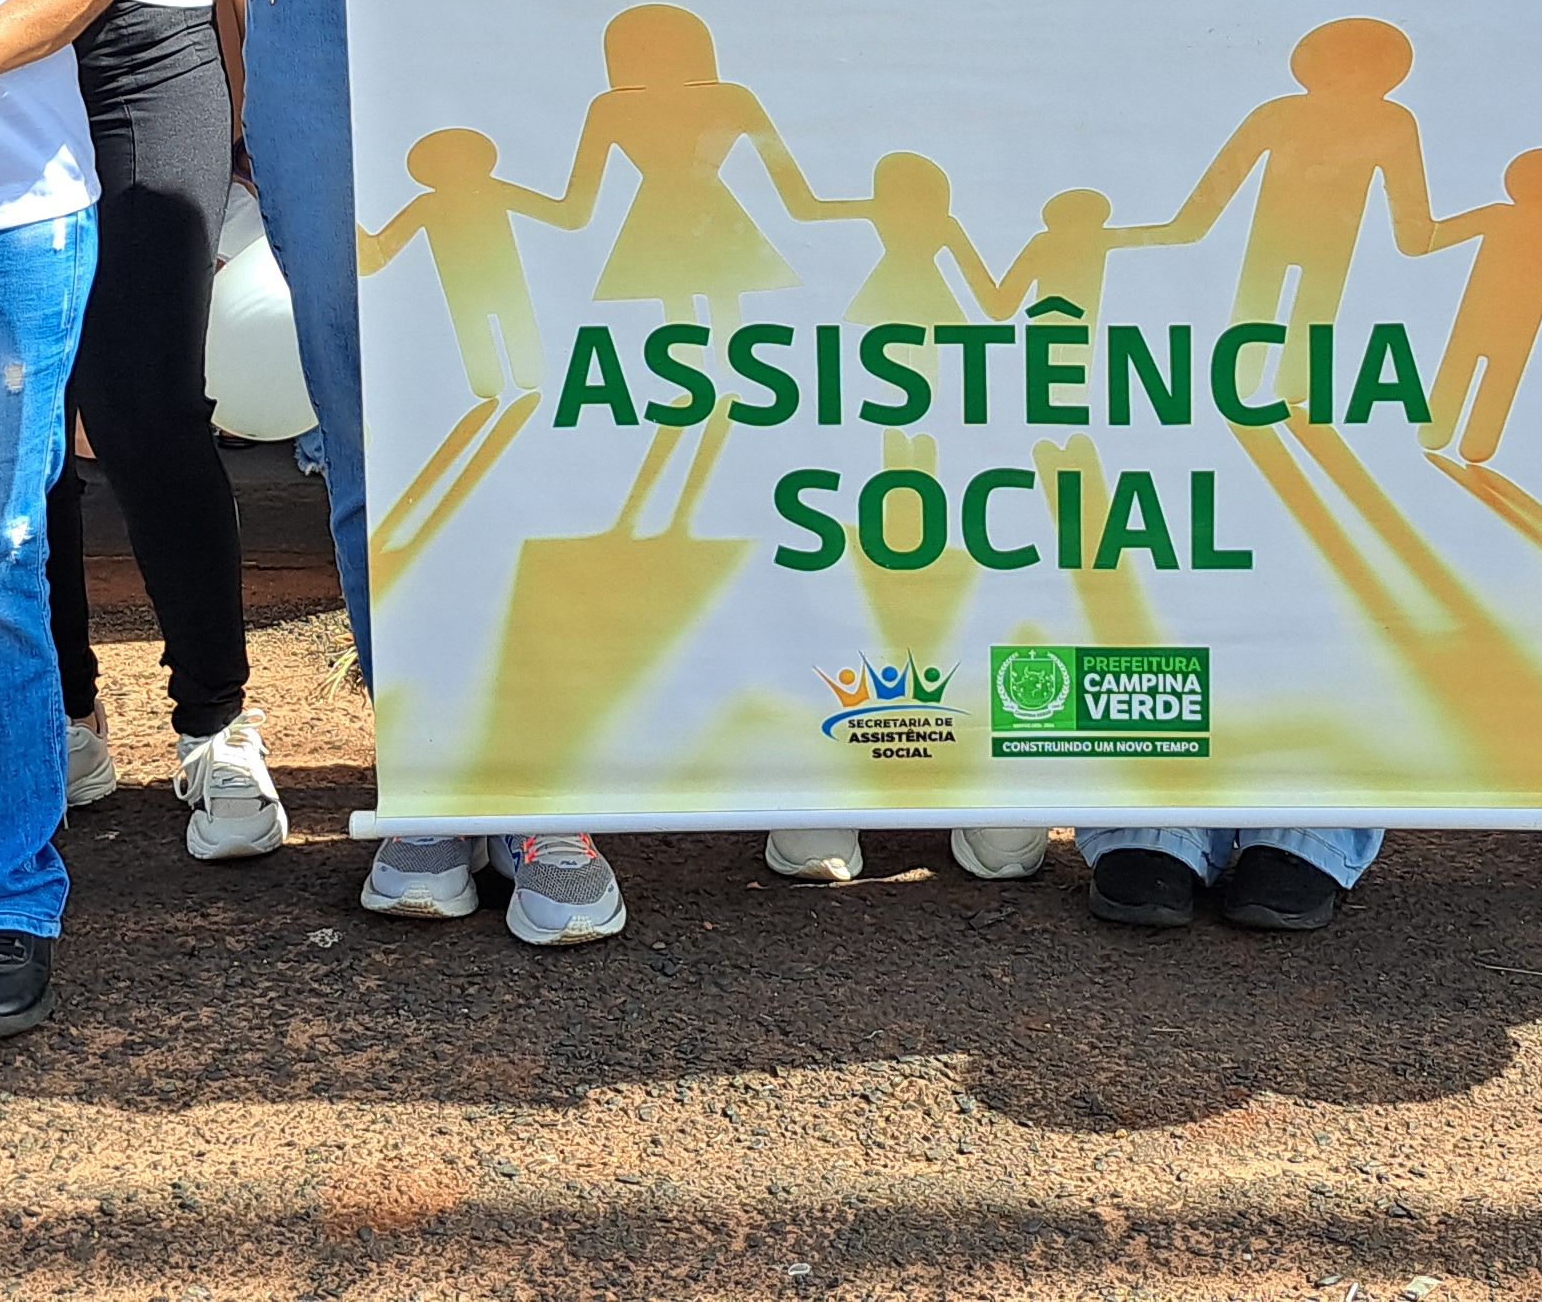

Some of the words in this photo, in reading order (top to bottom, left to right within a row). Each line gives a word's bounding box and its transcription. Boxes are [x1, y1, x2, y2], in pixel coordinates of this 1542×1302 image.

[553, 296, 1433, 427] ASSISTÊNCIA
[773, 467, 1254, 571] SOCIAL
[1083, 656, 1202, 672] PREFEITURA
[1083, 672, 1202, 693] CAMPINA
[1084, 693, 1203, 721] VERDE
[848, 718, 932, 728] SECRETARIA
[935, 717, 954, 727] DE
[848, 727, 957, 744] ASSISTÊNCIA
[872, 747, 933, 759] SOCIAL
[1002, 741, 1092, 753] CONSTRUINDO
[1094, 741, 1114, 753] UM
[1115, 741, 1153, 753] NOVO
[1155, 741, 1199, 753] TEMPO
